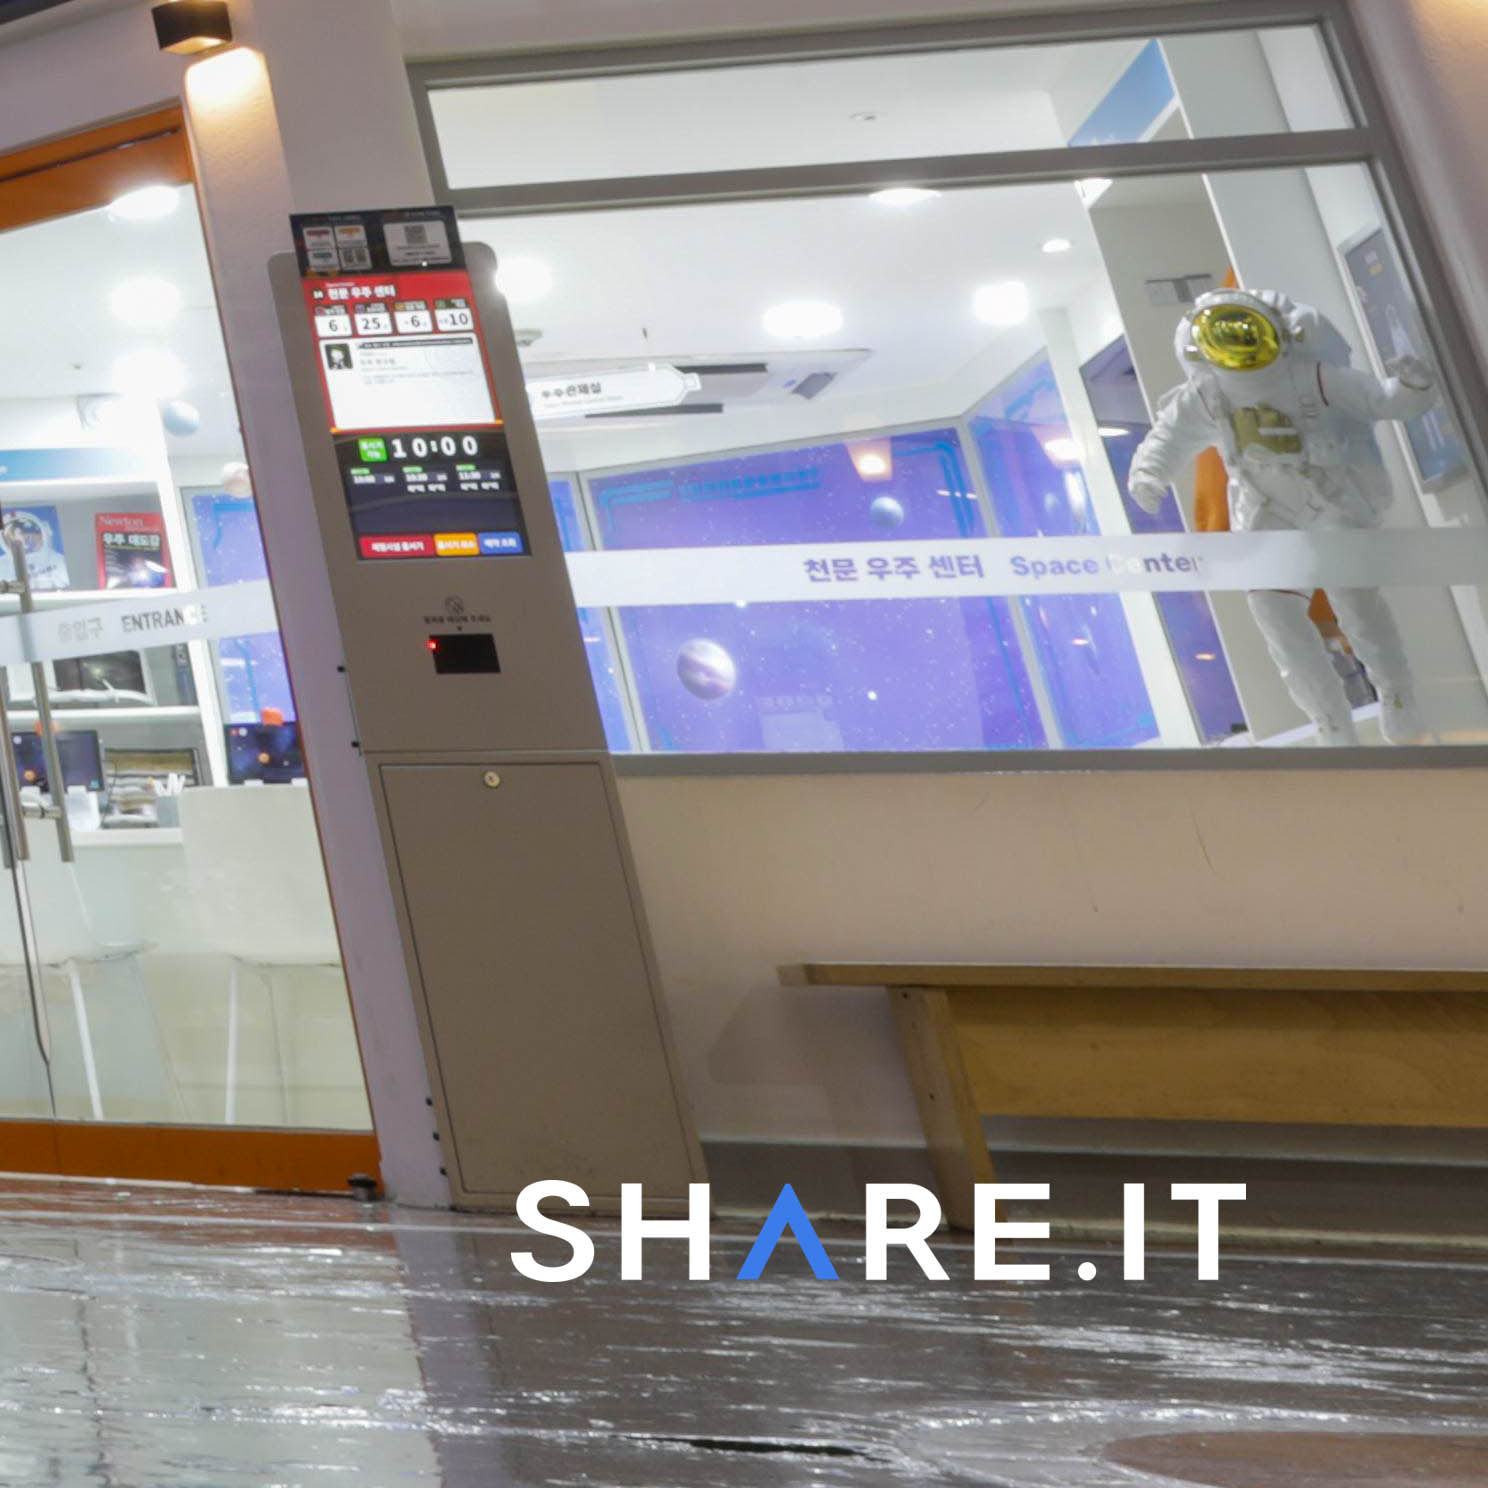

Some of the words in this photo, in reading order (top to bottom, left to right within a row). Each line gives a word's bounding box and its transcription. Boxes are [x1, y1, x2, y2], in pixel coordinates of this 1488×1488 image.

[362, 317, 382, 330] 25
[450, 313, 469, 326] 10
[392, 436, 478, 458] 10:00
[803, 557, 859, 584] 천문
[866, 556, 921, 581] 우주
[928, 554, 984, 580] 센터
[1010, 555, 1099, 581] Space
